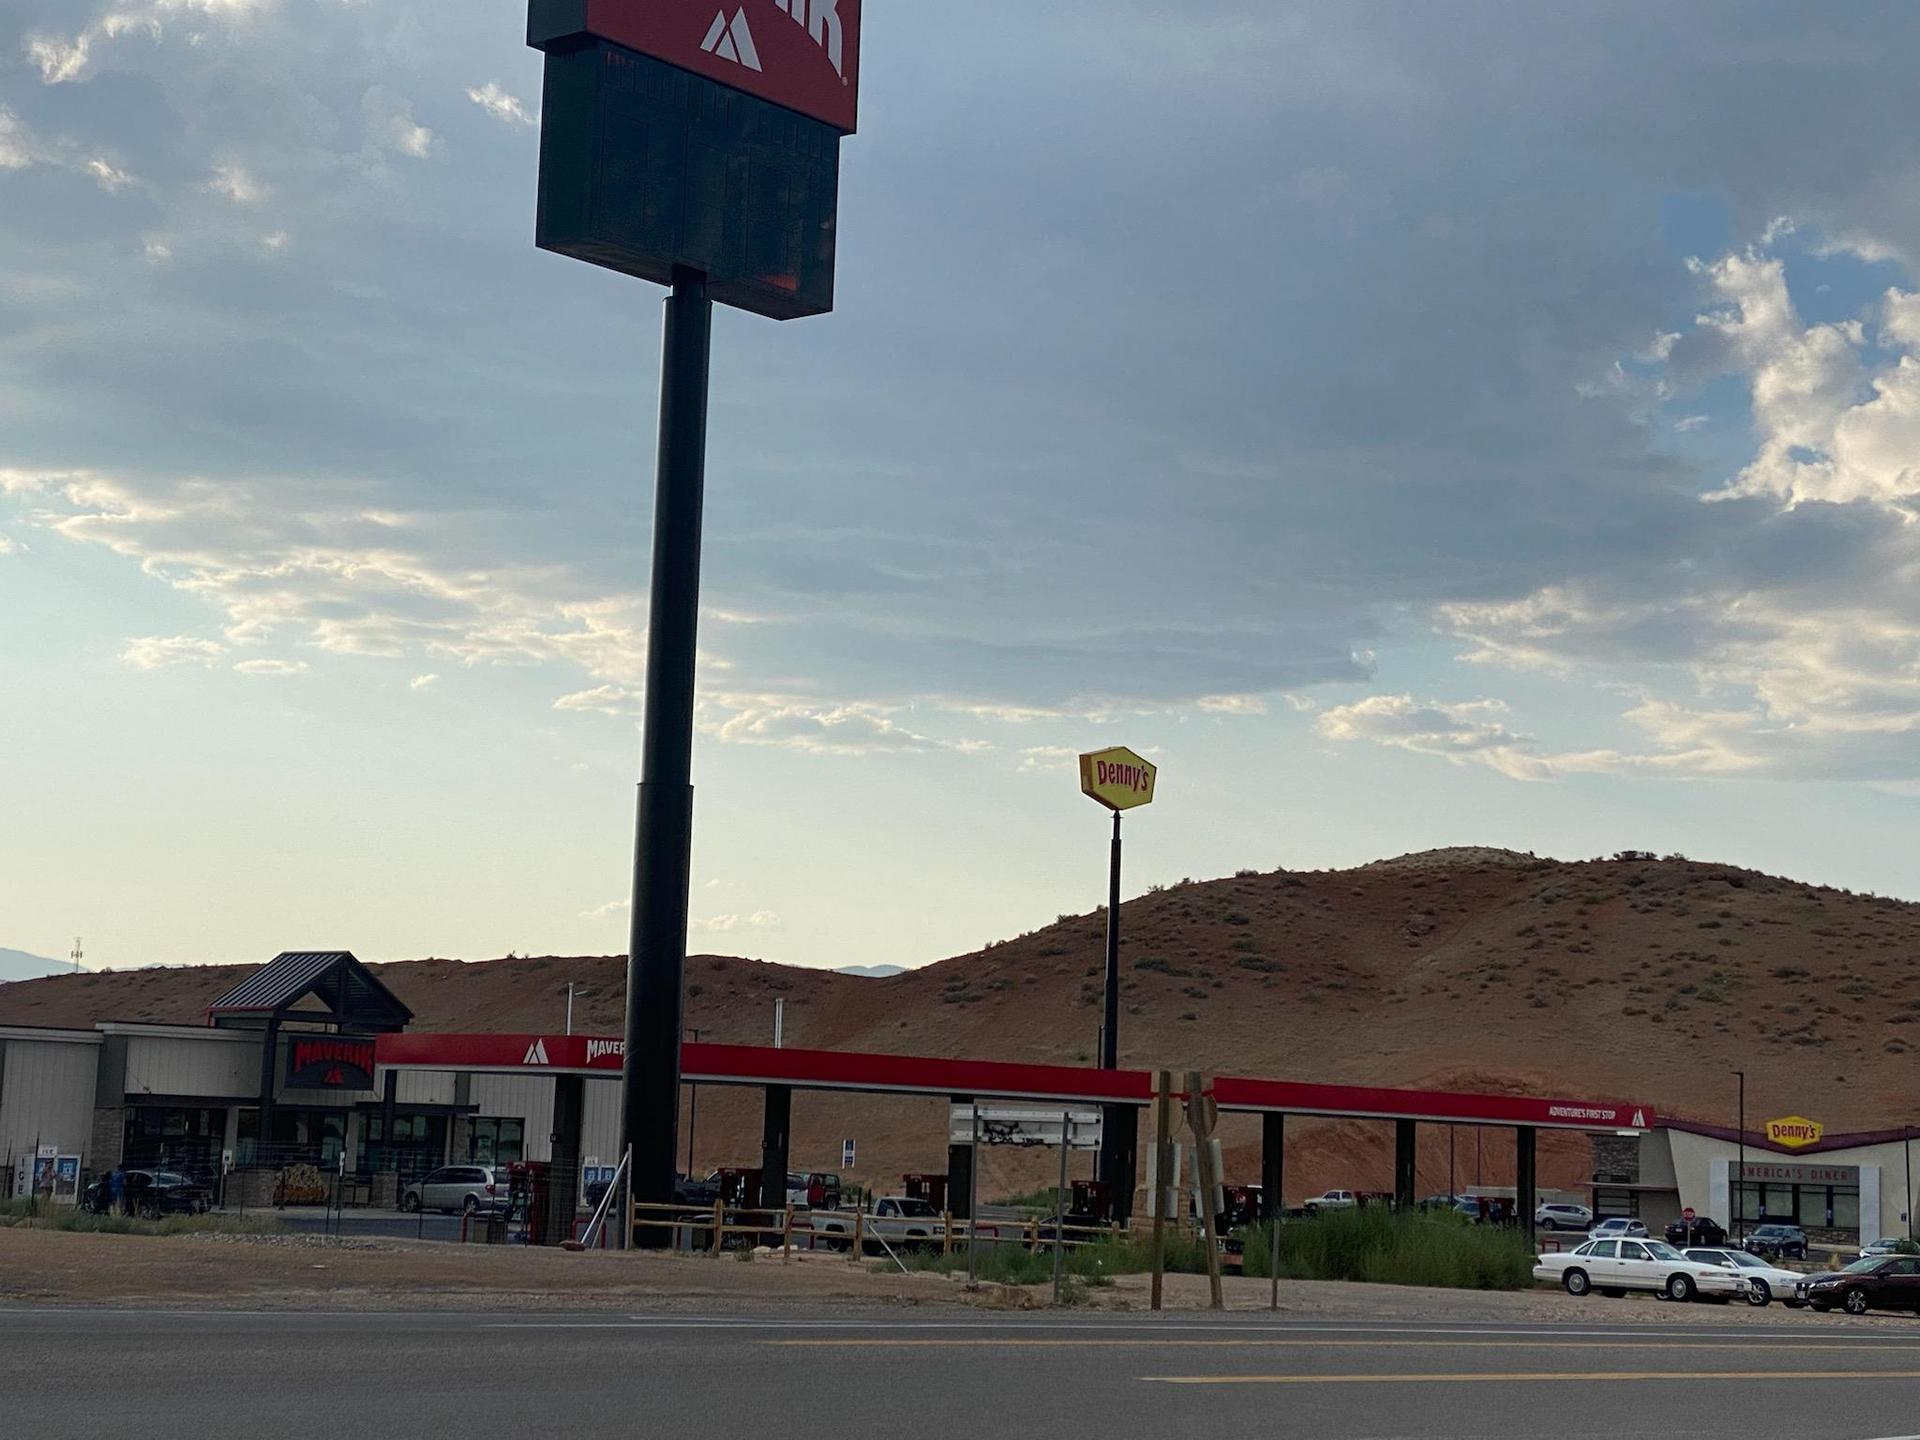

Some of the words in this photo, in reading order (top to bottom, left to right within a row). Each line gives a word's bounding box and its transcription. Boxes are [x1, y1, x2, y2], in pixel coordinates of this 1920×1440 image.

[1097, 760, 1149, 792] Denny's
[1586, 1108, 1601, 1119] FIRST
[1601, 1110, 1616, 1120] STOP
[1772, 1124, 1816, 1140] Denny's
[1811, 1169, 1848, 1181] DINER
